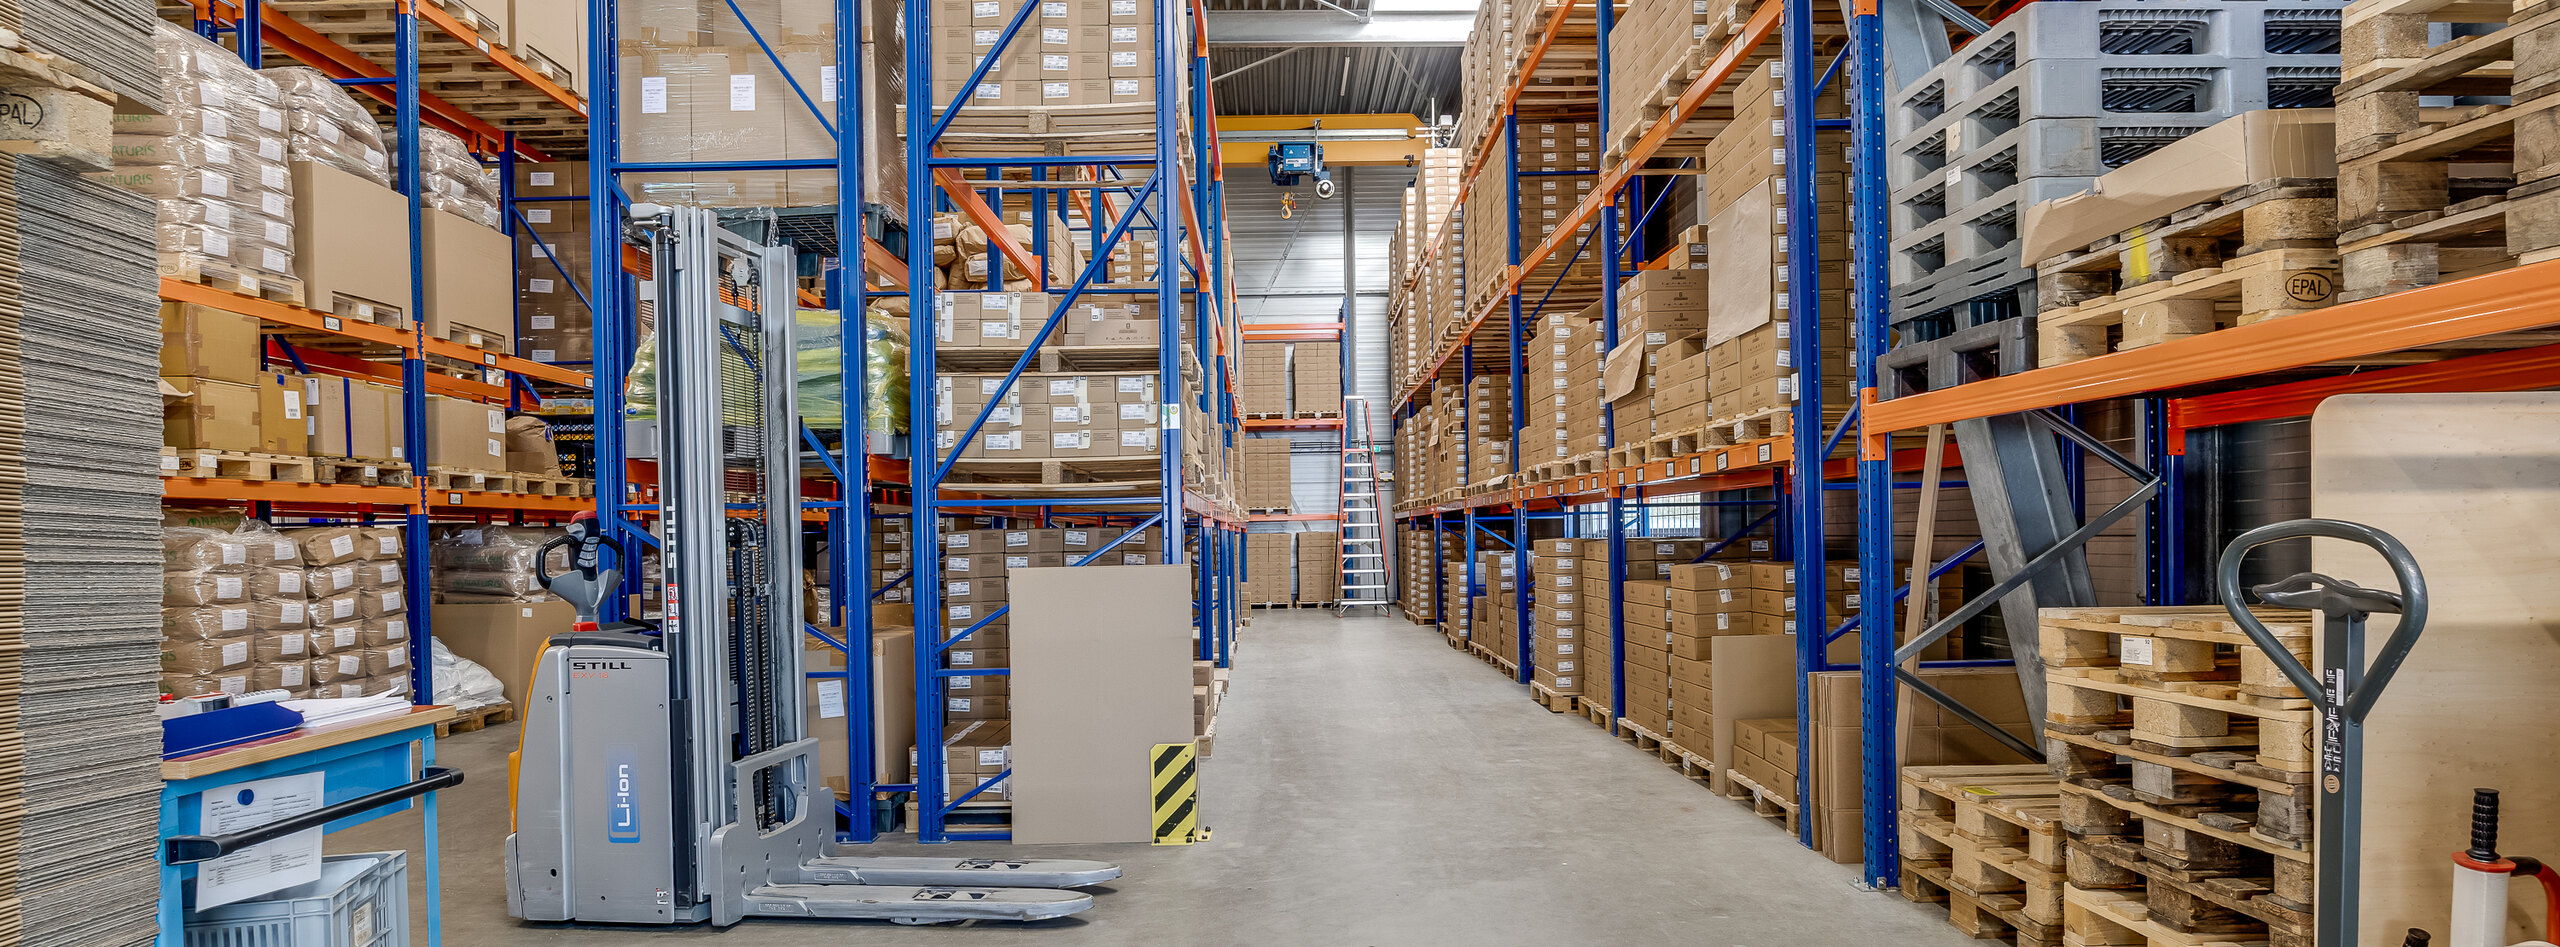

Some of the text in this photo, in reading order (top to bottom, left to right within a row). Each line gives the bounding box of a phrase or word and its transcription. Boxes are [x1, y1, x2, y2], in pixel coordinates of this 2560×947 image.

[2292, 279, 2325, 296] EPAL
[666, 497, 677, 569] STILL
[573, 662, 631, 670] STILL
[617, 764, 630, 827] Li-Ion
